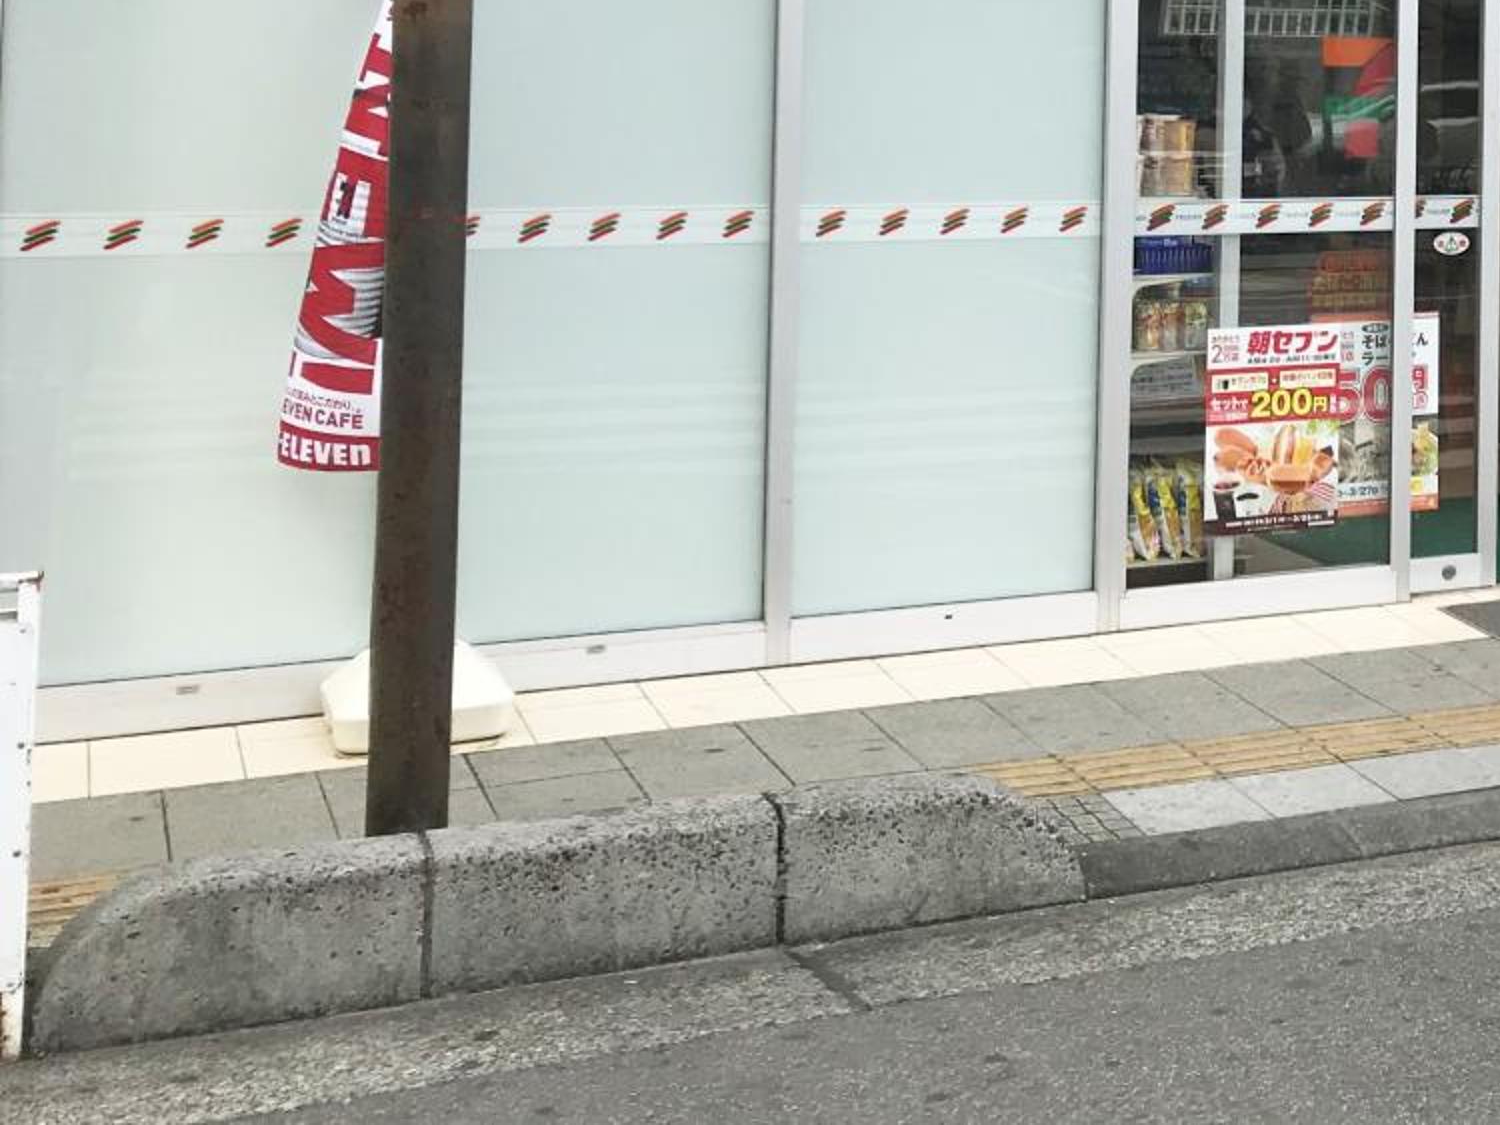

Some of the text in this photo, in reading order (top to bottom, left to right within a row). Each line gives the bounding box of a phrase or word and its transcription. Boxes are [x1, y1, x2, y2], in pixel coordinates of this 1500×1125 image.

[1247, 330, 1339, 356] 朝セブン
[283, 398, 313, 423] EVEN
[1250, 388, 1329, 418] 200円
